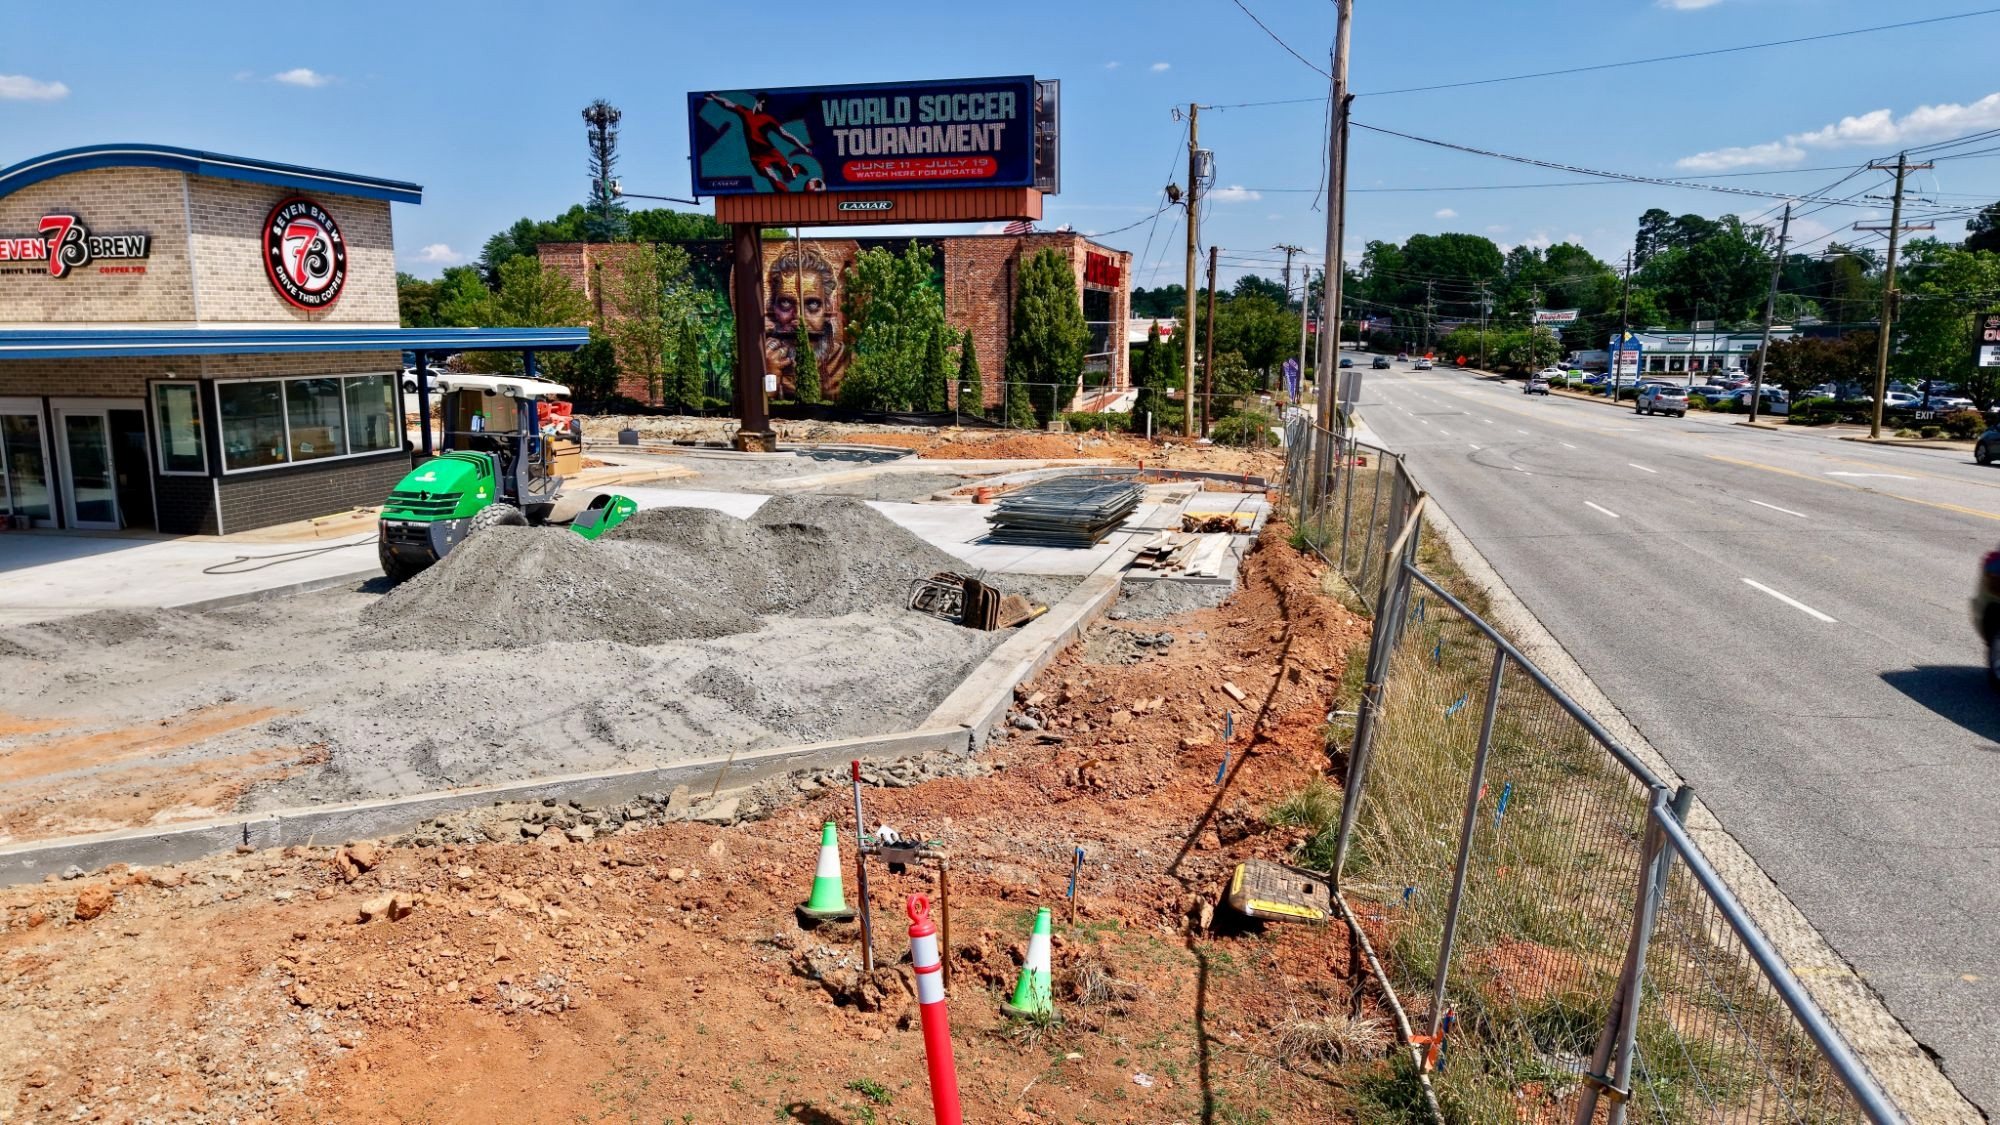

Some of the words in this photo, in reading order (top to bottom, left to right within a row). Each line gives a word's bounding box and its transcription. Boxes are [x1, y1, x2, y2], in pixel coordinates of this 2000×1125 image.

[821, 96, 911, 127] WORLD
[918, 91, 1016, 123] SOCCER
[832, 122, 1006, 157] TOURNAMENT
[850, 161, 896, 171] JUNE
[899, 161, 911, 170] 11
[925, 160, 966, 169] JULY
[973, 158, 988, 167] 19
[856, 170, 889, 179] WATCH
[890, 169, 916, 178] HERE
[918, 169, 938, 177] FOR
[939, 168, 984, 176] UPDATES
[842, 201, 889, 210] LAMAR
[273, 203, 307, 236] SEVEN
[311, 206, 341, 242] BREW
[0, 237, 47, 260] EVEN
[88, 235, 146, 259] BREW
[1, 267, 24, 275] DRIVE
[27, 267, 48, 275] THRU
[276, 265, 298, 296] DRIVE
[298, 291, 321, 304] THRU
[321, 270, 344, 302] COFFEE
[1915, 411, 1935, 420] EXIT
